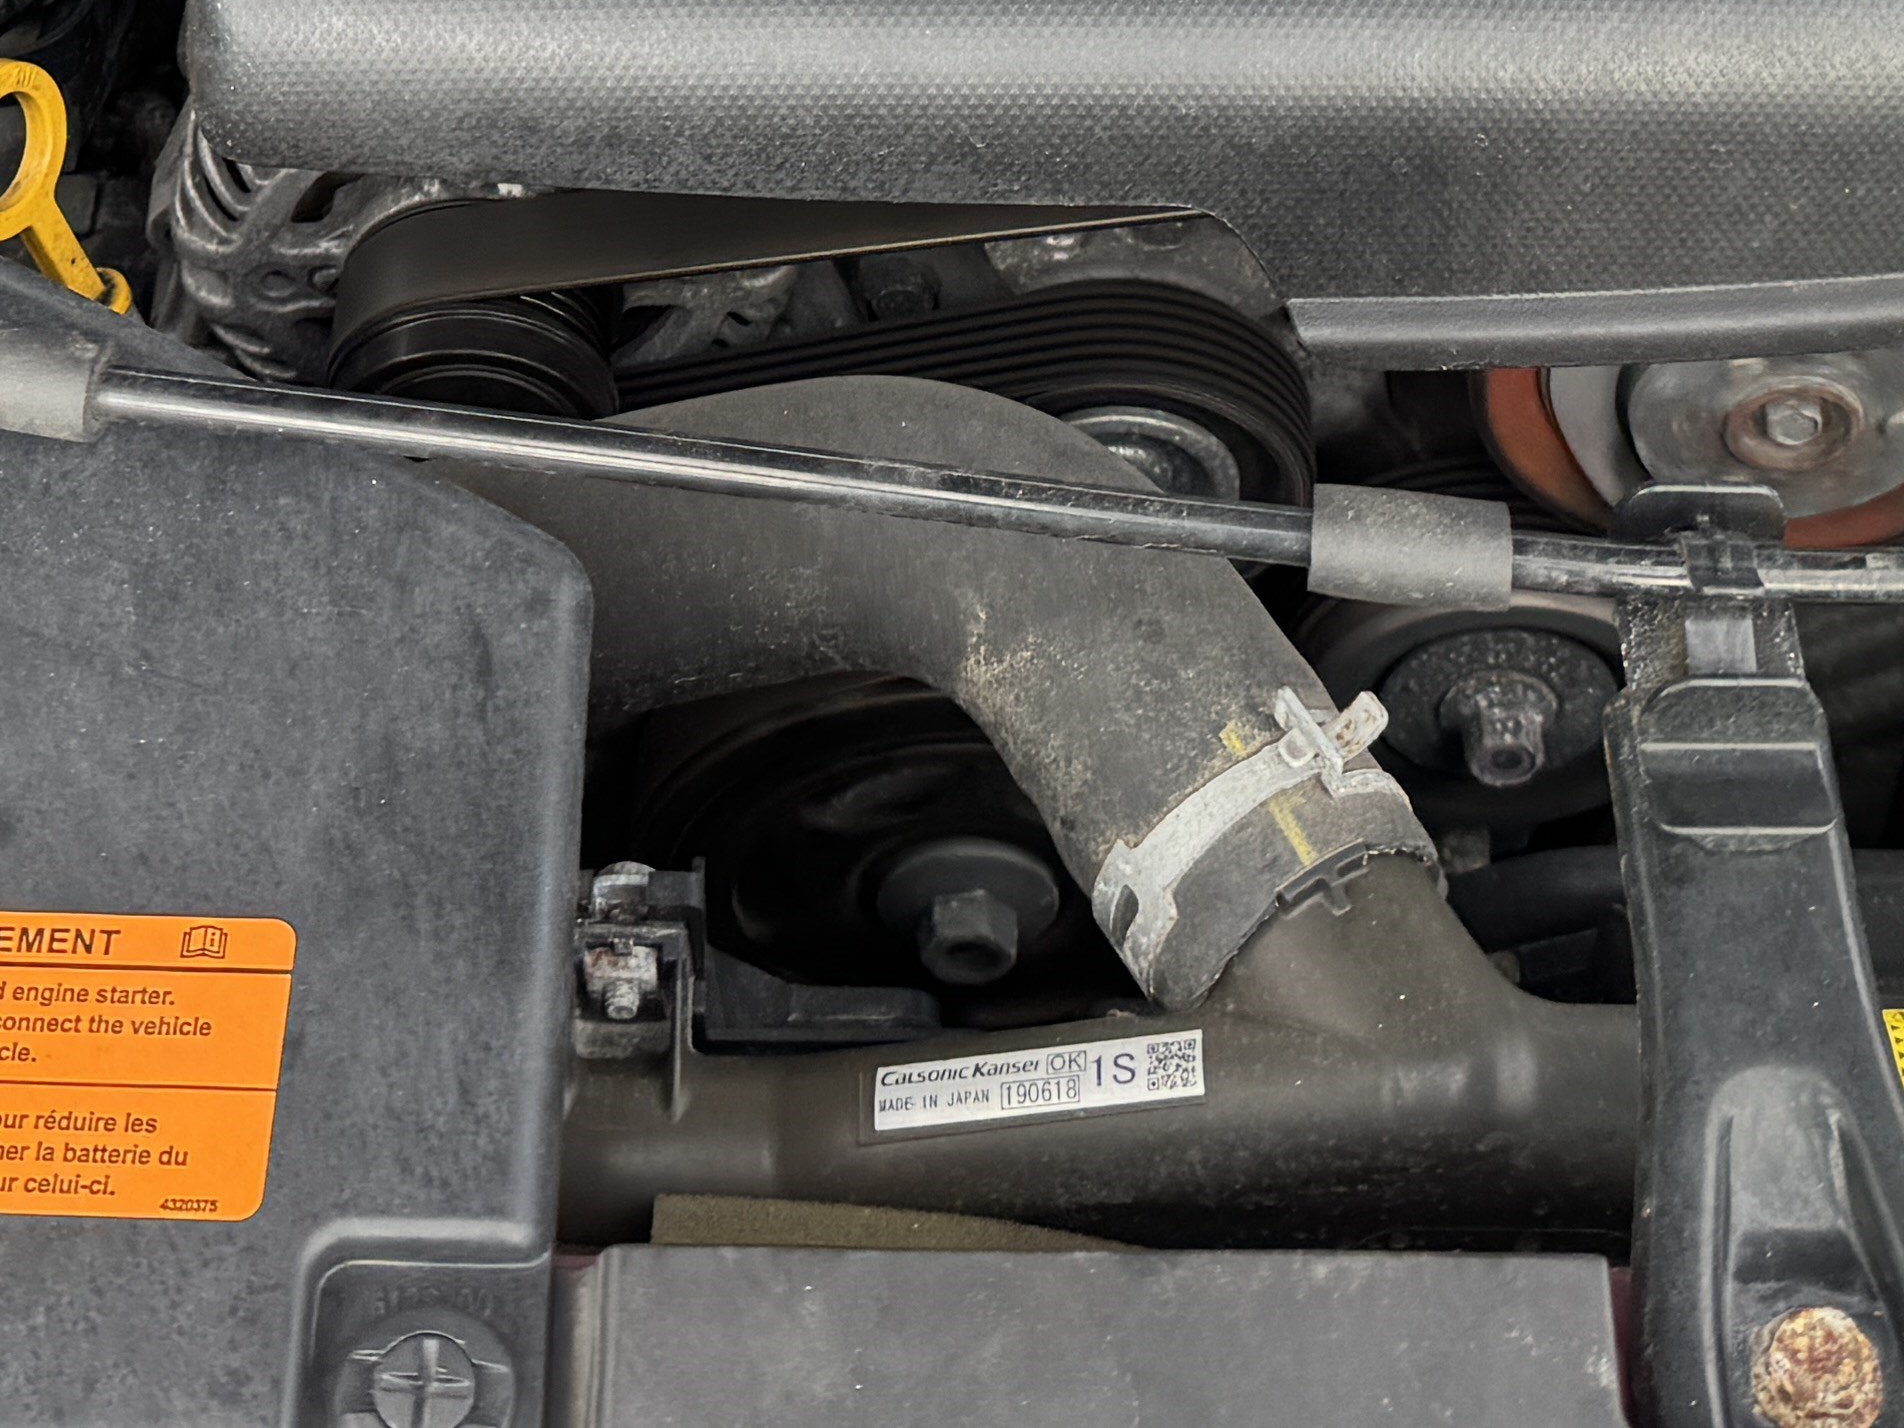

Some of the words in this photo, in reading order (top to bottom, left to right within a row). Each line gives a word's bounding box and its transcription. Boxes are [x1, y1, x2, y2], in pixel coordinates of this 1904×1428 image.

[12, 982, 89, 1006] engine
[95, 986, 175, 1006] starter.
[88, 1015, 124, 1036] the
[130, 1016, 212, 1037] vehicle
[881, 1067, 970, 1087] Calsonic
[1050, 1053, 1084, 1072] OK
[878, 1096, 914, 1112] MADE
[923, 1094, 938, 1108] IN
[947, 1089, 990, 1106] JAPAN
[1004, 1079, 1077, 1105] 190618
[33, 1110, 116, 1132] réduire
[124, 1112, 158, 1134] les
[34, 1142, 55, 1163] la
[62, 1143, 152, 1166] batterie
[158, 1145, 189, 1167] du
[23, 1174, 116, 1196] celui-ci.
[159, 1198, 218, 1213] 4320375
